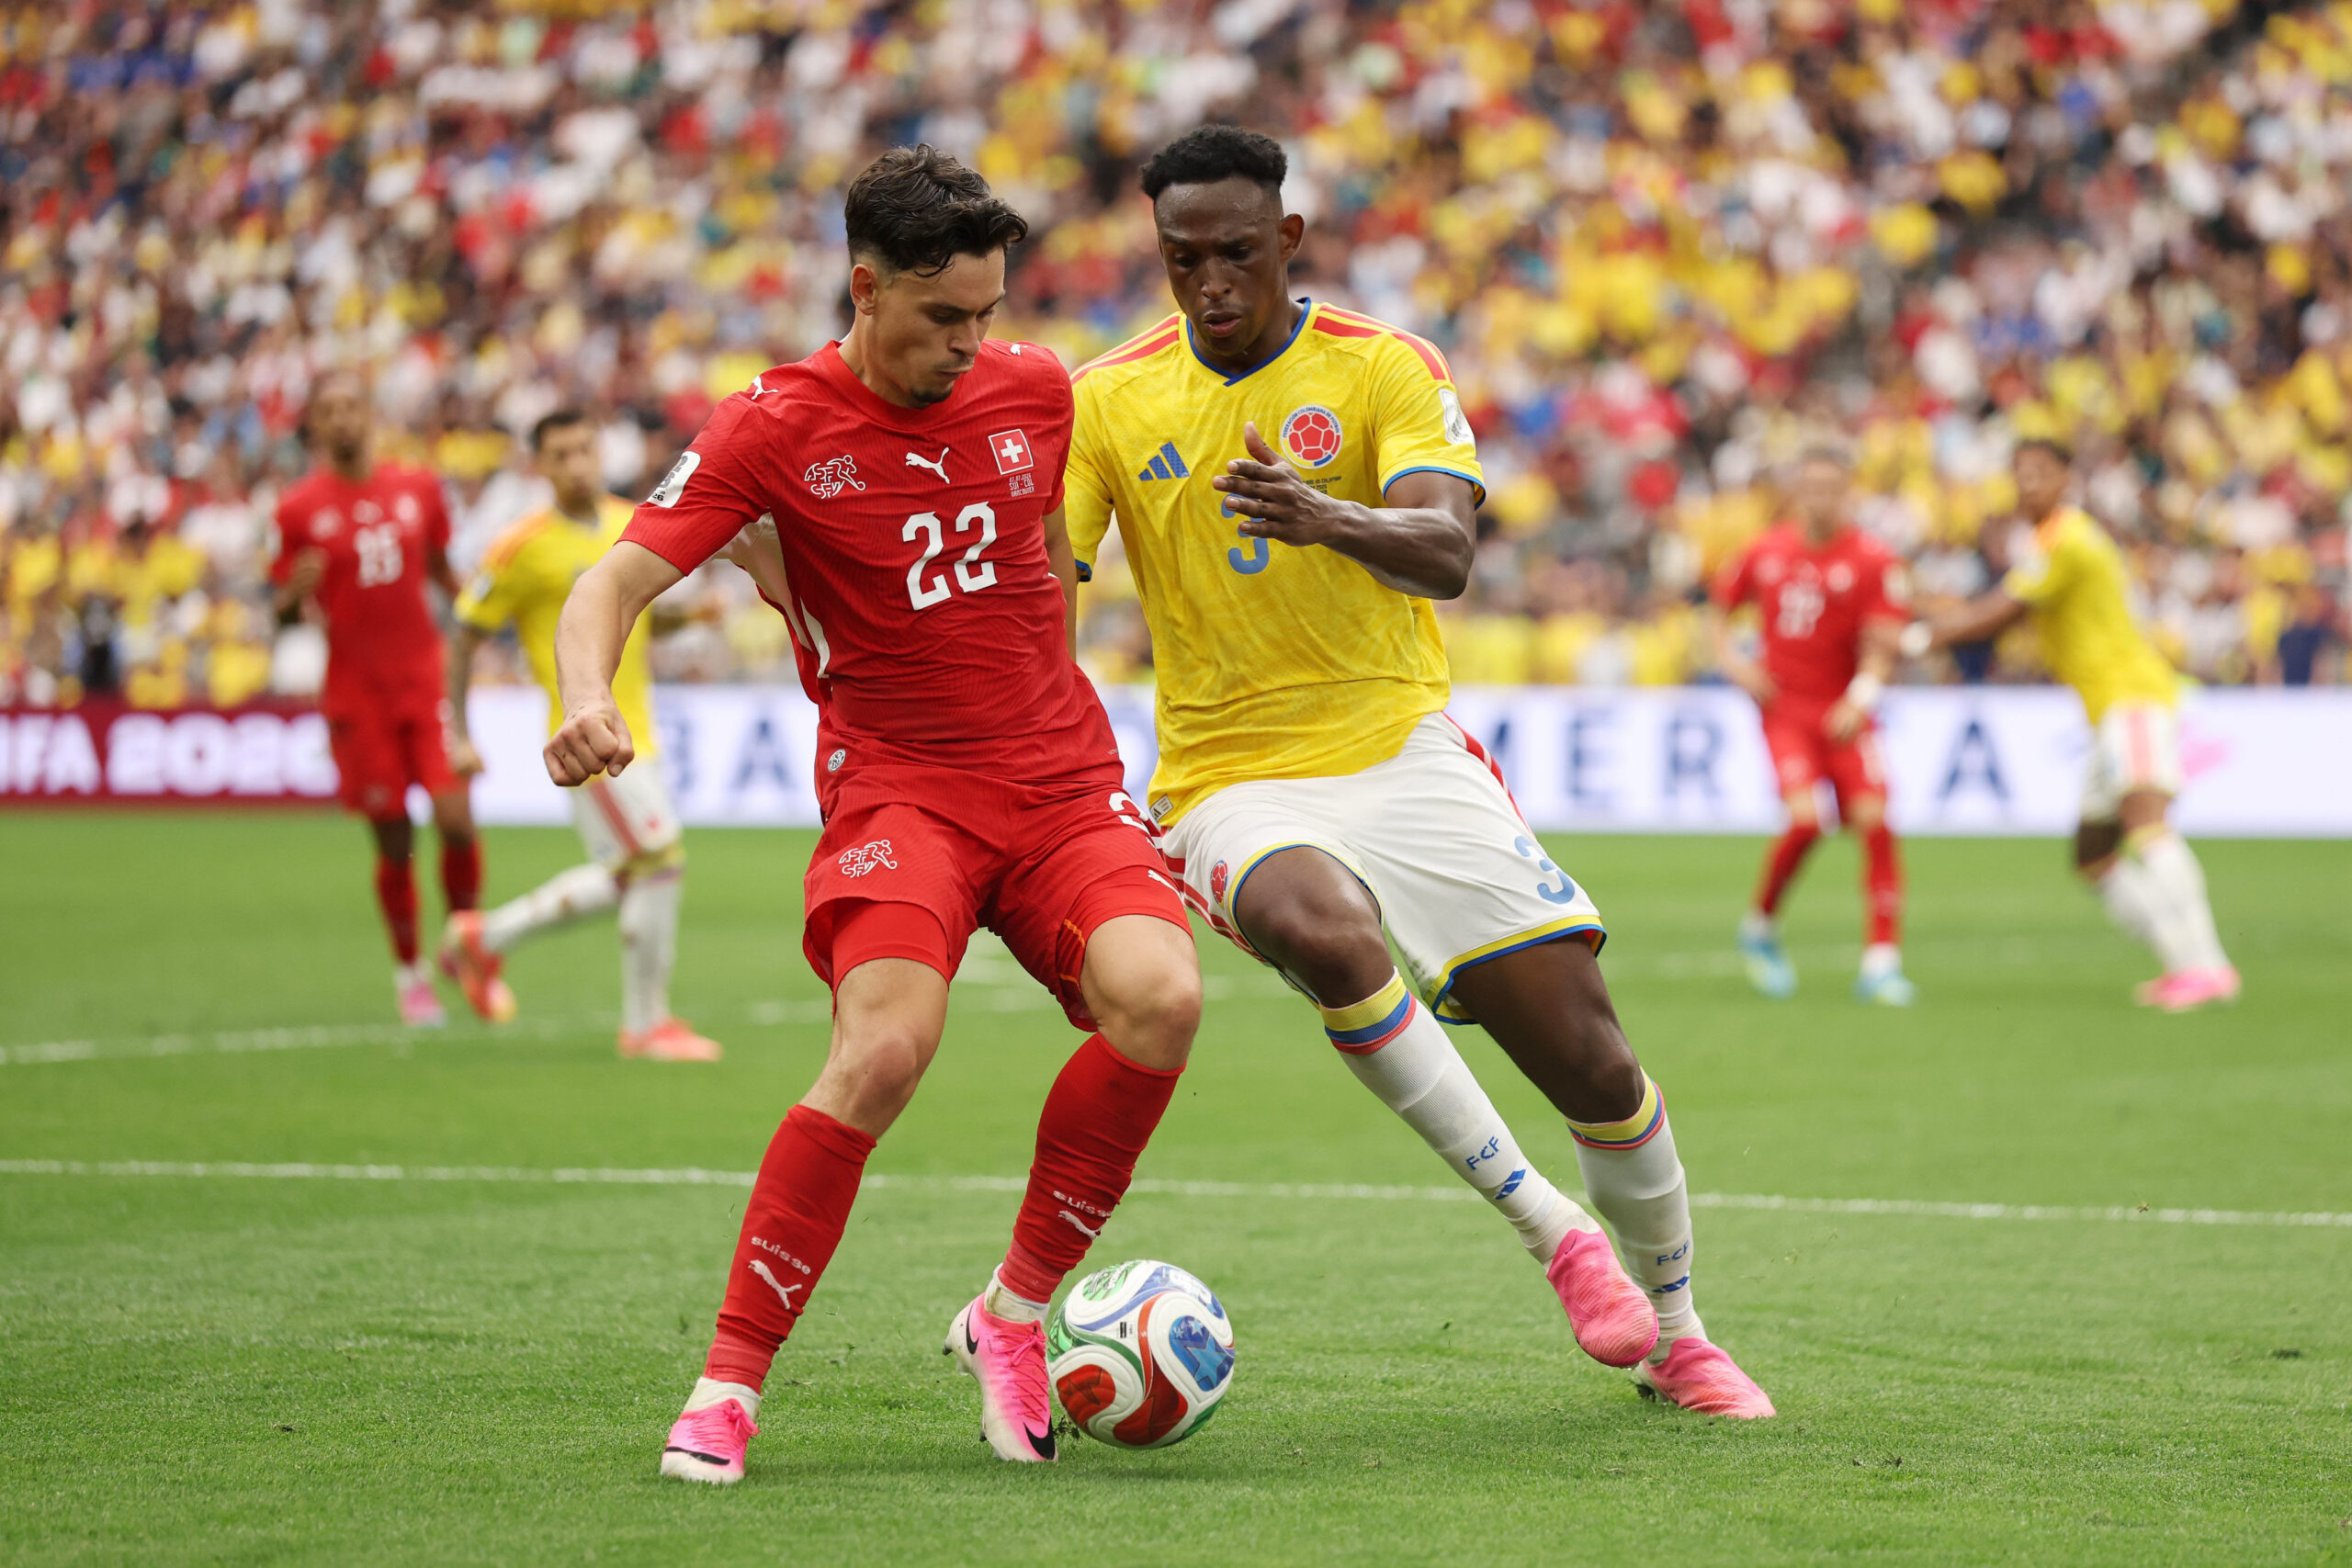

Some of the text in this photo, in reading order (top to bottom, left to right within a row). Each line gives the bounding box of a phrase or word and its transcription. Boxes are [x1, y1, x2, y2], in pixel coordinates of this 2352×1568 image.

[901, 501, 999, 611] 22
[1514, 835, 1576, 905] 3
[1465, 1135, 1499, 1171] FCF
[1657, 1239, 1690, 1267] FCF
